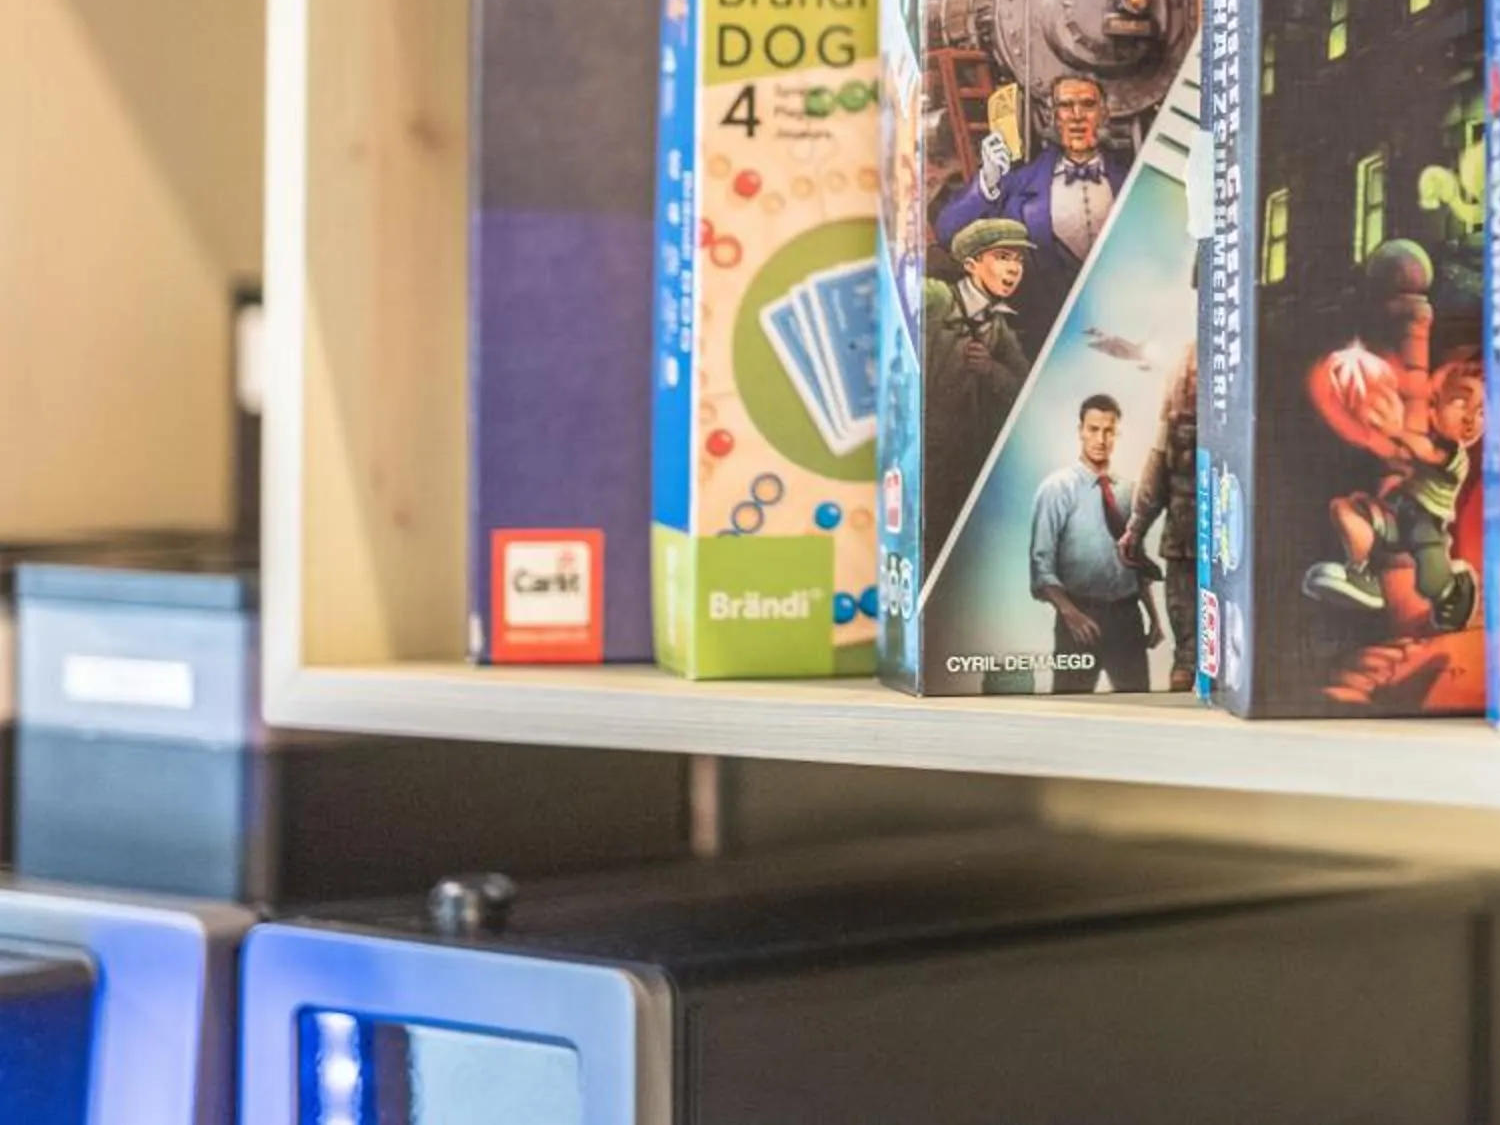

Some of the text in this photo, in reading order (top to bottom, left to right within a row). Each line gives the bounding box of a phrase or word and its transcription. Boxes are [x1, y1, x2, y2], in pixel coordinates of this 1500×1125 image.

[716, 24, 857, 69] DOG
[720, 83, 762, 138] 4
[945, 653, 1096, 673] CYRIL DEMAEGD
